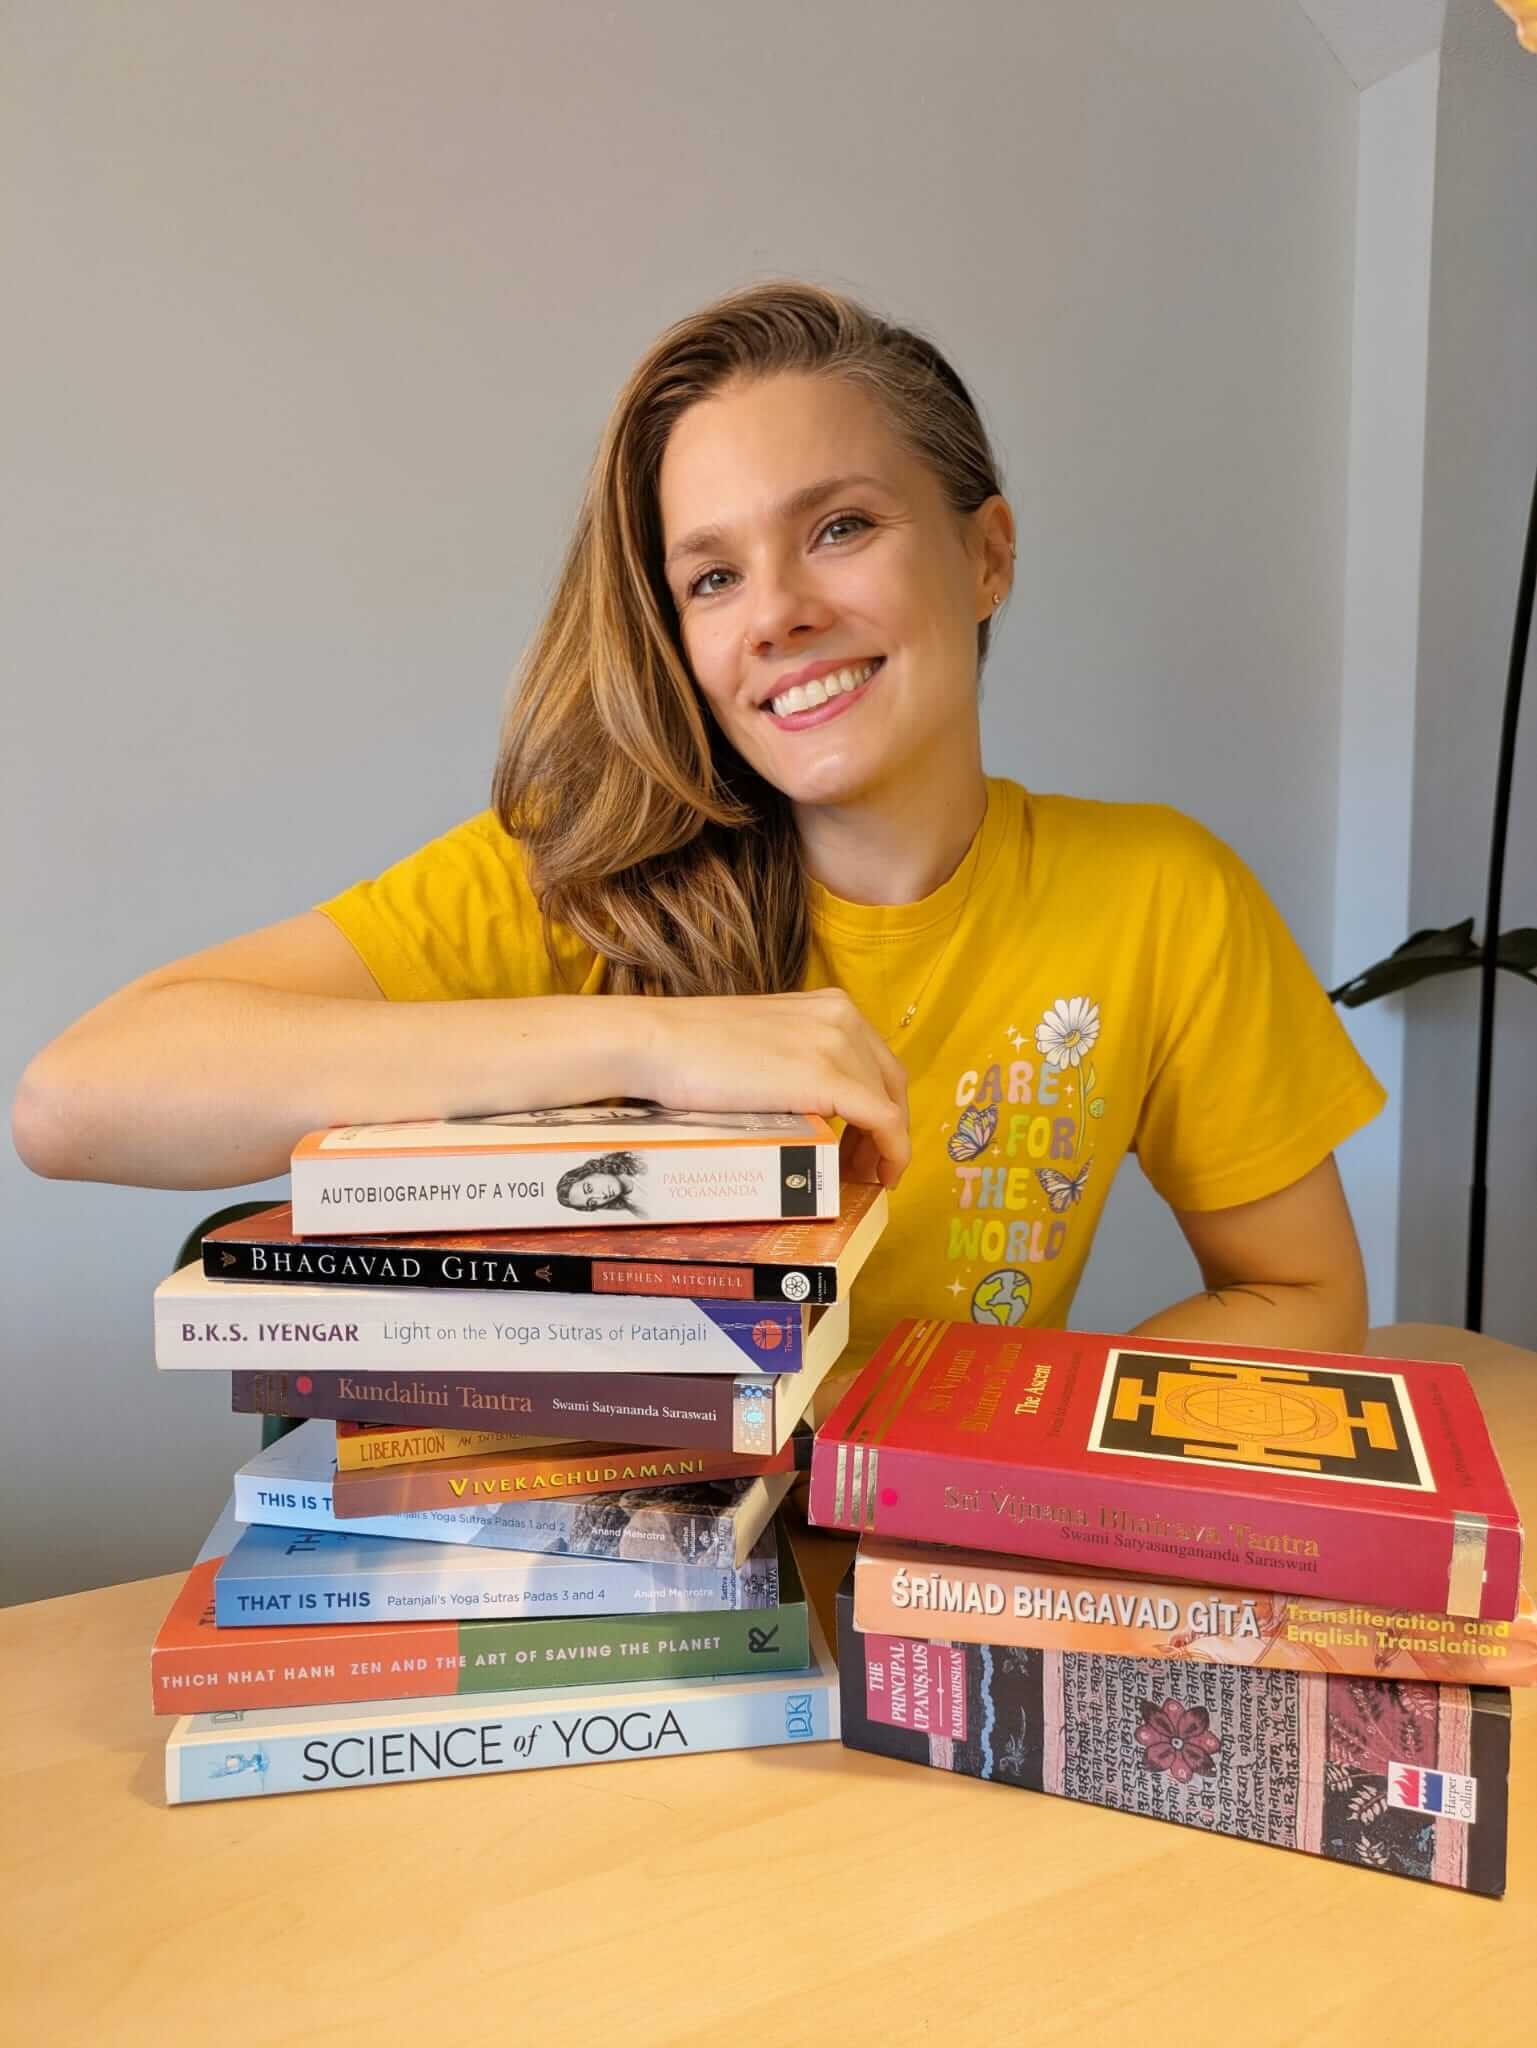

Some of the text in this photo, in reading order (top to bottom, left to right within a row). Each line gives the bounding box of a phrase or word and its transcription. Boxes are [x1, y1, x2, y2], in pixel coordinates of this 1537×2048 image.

[956, 1060, 1062, 1106] CARE
[1007, 1115, 1076, 1160] FOR
[321, 1181, 544, 1204] AUTOBIOGRAPHY OF A YOGI
[663, 1171, 764, 1185] PARAMAHANSA
[669, 1184, 759, 1199] YOGANANDA
[955, 1167, 1030, 1211] THE
[948, 1217, 1067, 1263] WORLD
[252, 1247, 520, 1283] BHAGAVAD GITA
[602, 1271, 743, 1288] STEPHEN MITCHELL
[182, 1323, 360, 1342] B.K.S. IYENGAR
[384, 1321, 432, 1345] Light
[437, 1328, 456, 1340] on
[462, 1323, 488, 1340] the
[495, 1324, 541, 1345] Yoga
[608, 1323, 625, 1341] of
[337, 1377, 532, 1412] Kundalini Tantra
[1015, 1363, 1052, 1415] The Ascent
[552, 1398, 717, 1421] Swami Satyananda Saraswati
[360, 1435, 446, 1462] LIBERATION
[448, 1459, 704, 1498] VIVEKACHUDAMANI
[257, 1491, 296, 1508] THIS
[302, 1495, 317, 1510] IS
[430, 1511, 457, 1523] Yoga
[459, 1513, 492, 1526] Sutras
[494, 1517, 527, 1529] Padas
[535, 1519, 557, 1531] and
[558, 1520, 566, 1532] 2
[591, 1526, 621, 1538] Anand
[944, 1485, 981, 1513] Sri
[990, 1486, 1088, 1527] Vijnana
[1230, 1524, 1321, 1557] Tantra
[1061, 1526, 1318, 1573] Swami Satyasangananda Saraswati
[237, 1592, 371, 1611] THAT IS THIS
[387, 1589, 605, 1609] Patanjali's Yoga Sutras Padas 3 and 4
[633, 1587, 666, 1600] Anand
[1013, 1586, 1180, 1631] BHAGAVAD
[1287, 1602, 1511, 1639] Transliteration and
[1287, 1624, 1508, 1658] English Translation
[162, 1637, 721, 1689] THICH NHAT HANH ZEN AND THE ART OF SAVING THE PLANET
[868, 1661, 884, 1693] THE
[890, 1642, 906, 1723] PRINCIPAL
[788, 1697, 808, 1733] DK
[302, 1709, 688, 1782] SCIENCE of YOGA
[1444, 1775, 1459, 1818] Harper
[1459, 1777, 1474, 1819] Collins
